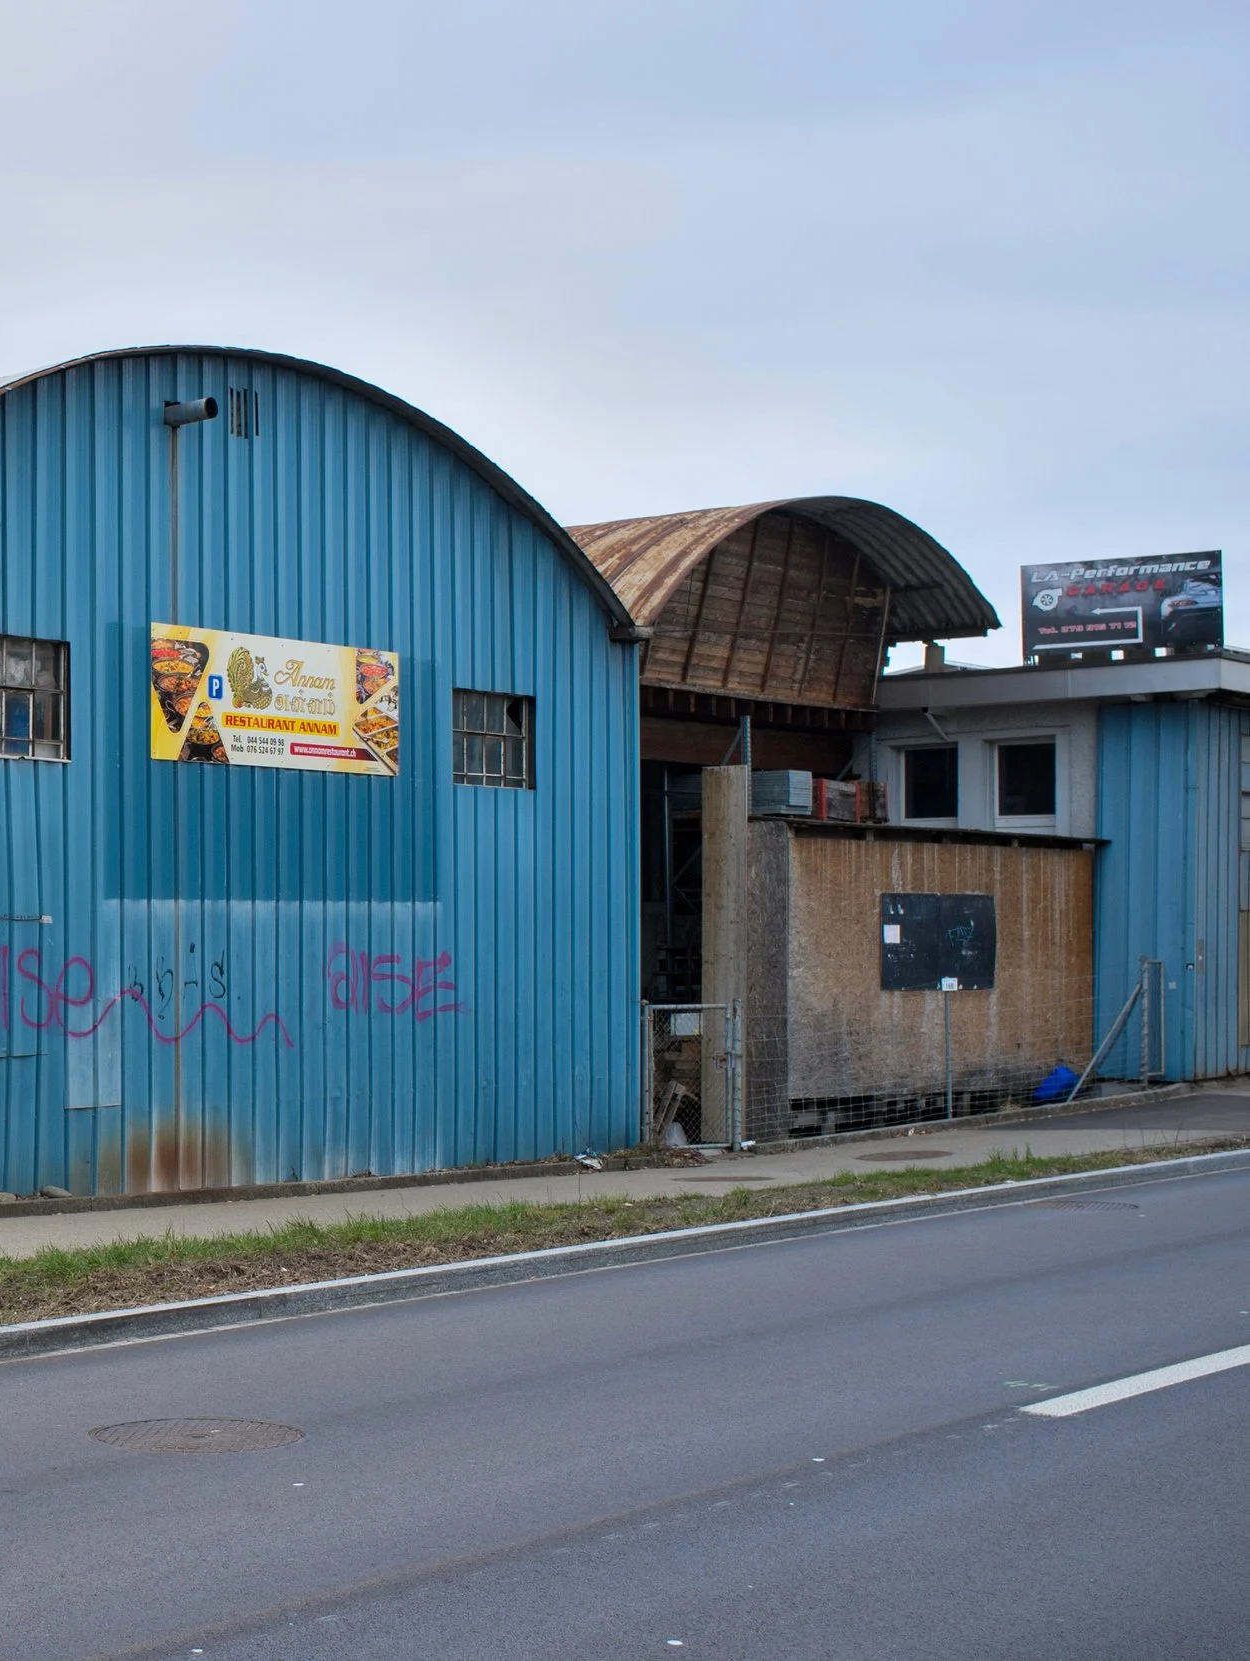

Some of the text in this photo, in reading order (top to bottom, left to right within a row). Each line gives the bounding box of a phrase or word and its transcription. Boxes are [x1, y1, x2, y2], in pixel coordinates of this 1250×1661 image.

[1030, 559, 1212, 583] LA-Performance
[274, 659, 336, 690] Annam
[212, 678, 220, 697] P
[225, 715, 338, 735] RESTAURANT ANNAM
[231, 744, 285, 756] Mob 076 524 67 97
[233, 735, 243, 743] Tel.
[247, 736, 258, 745] 044
[258, 736, 269, 746] 544
[270, 737, 277, 746] 09
